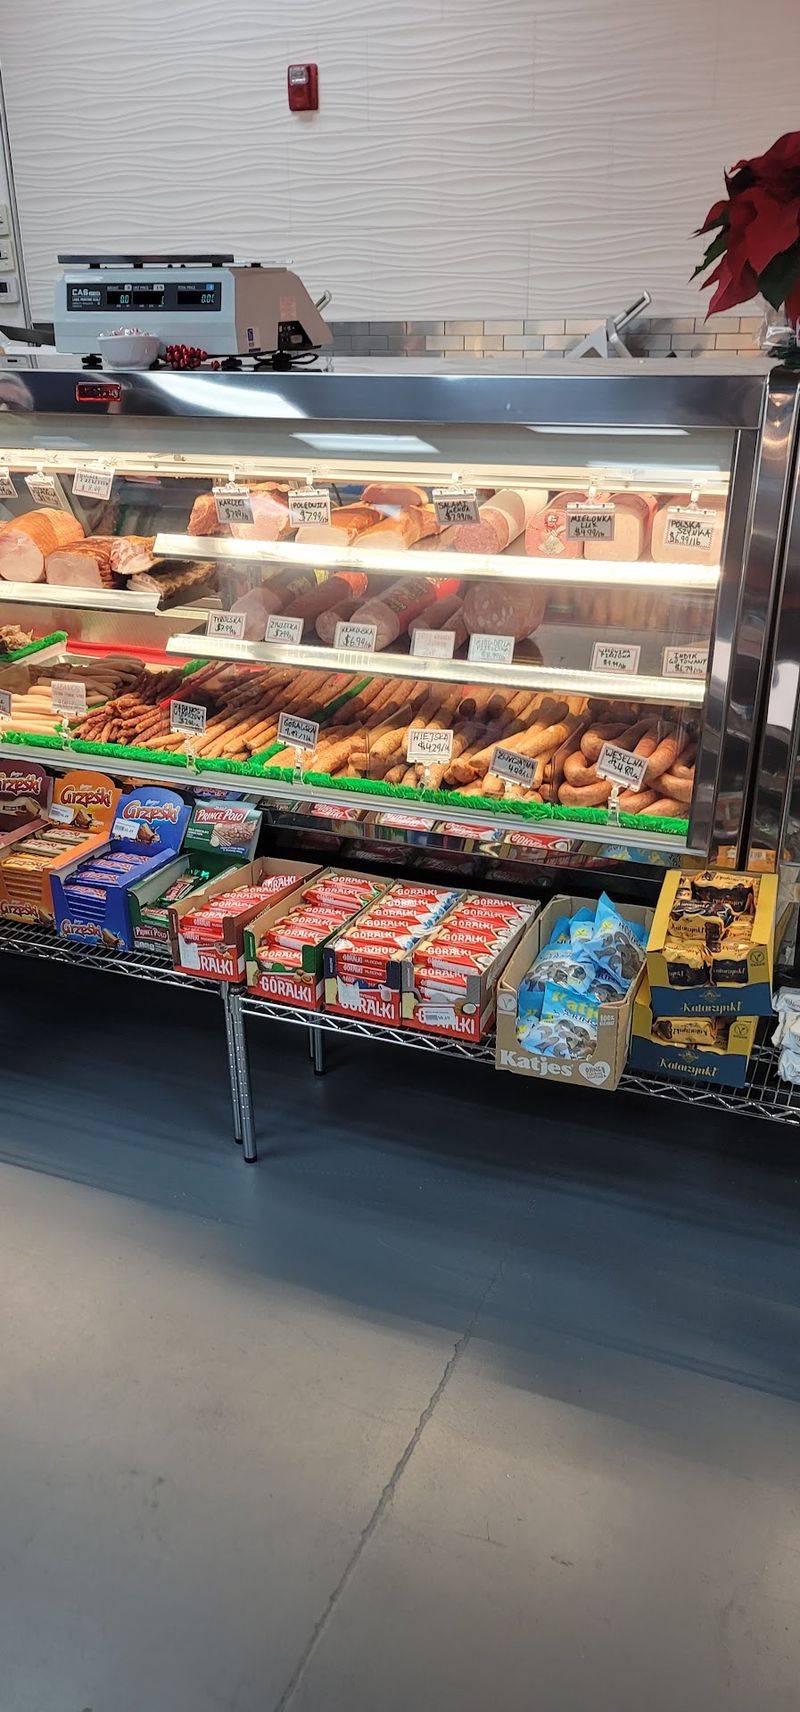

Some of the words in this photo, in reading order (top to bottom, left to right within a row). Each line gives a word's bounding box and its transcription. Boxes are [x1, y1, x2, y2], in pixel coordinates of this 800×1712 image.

[671, 519, 701, 529] POLSKA
[197, 810, 222, 822] PRINCE
[223, 809, 244, 821] POLO
[200, 955, 233, 976] RALKI
[683, 1001, 742, 1013] Katarzynki
[500, 1051, 573, 1077] Katjes
[660, 1058, 718, 1077] Katarzynki
